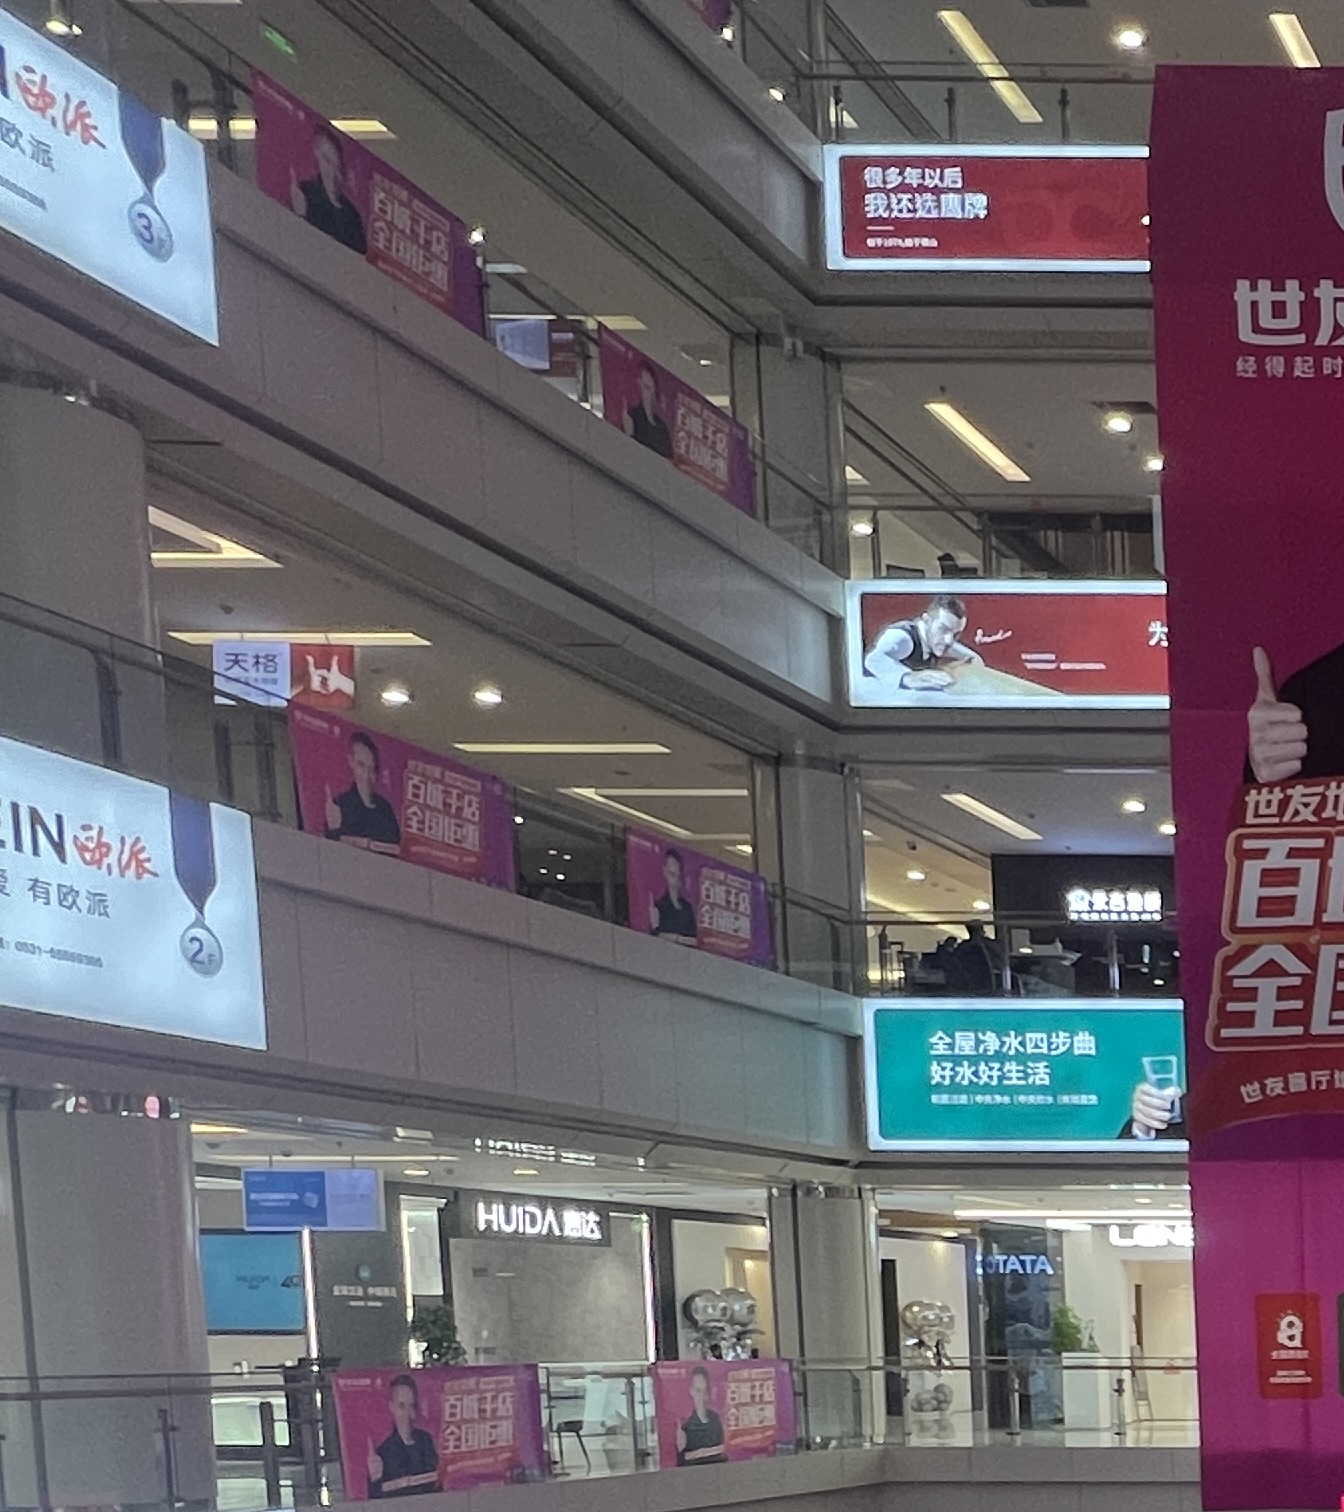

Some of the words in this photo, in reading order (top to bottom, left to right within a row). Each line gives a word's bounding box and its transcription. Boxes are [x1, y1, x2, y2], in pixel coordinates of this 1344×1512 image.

[864, 166, 963, 189] 很多年以后
[864, 193, 989, 219] 我还选鹰牌
[224, 652, 279, 674] 天格
[929, 1030, 1097, 1056] 全屋净水四步曲
[930, 1061, 1051, 1087] 好水好生活
[477, 1202, 562, 1238] HUIDA
[998, 1254, 1055, 1275] TATA
